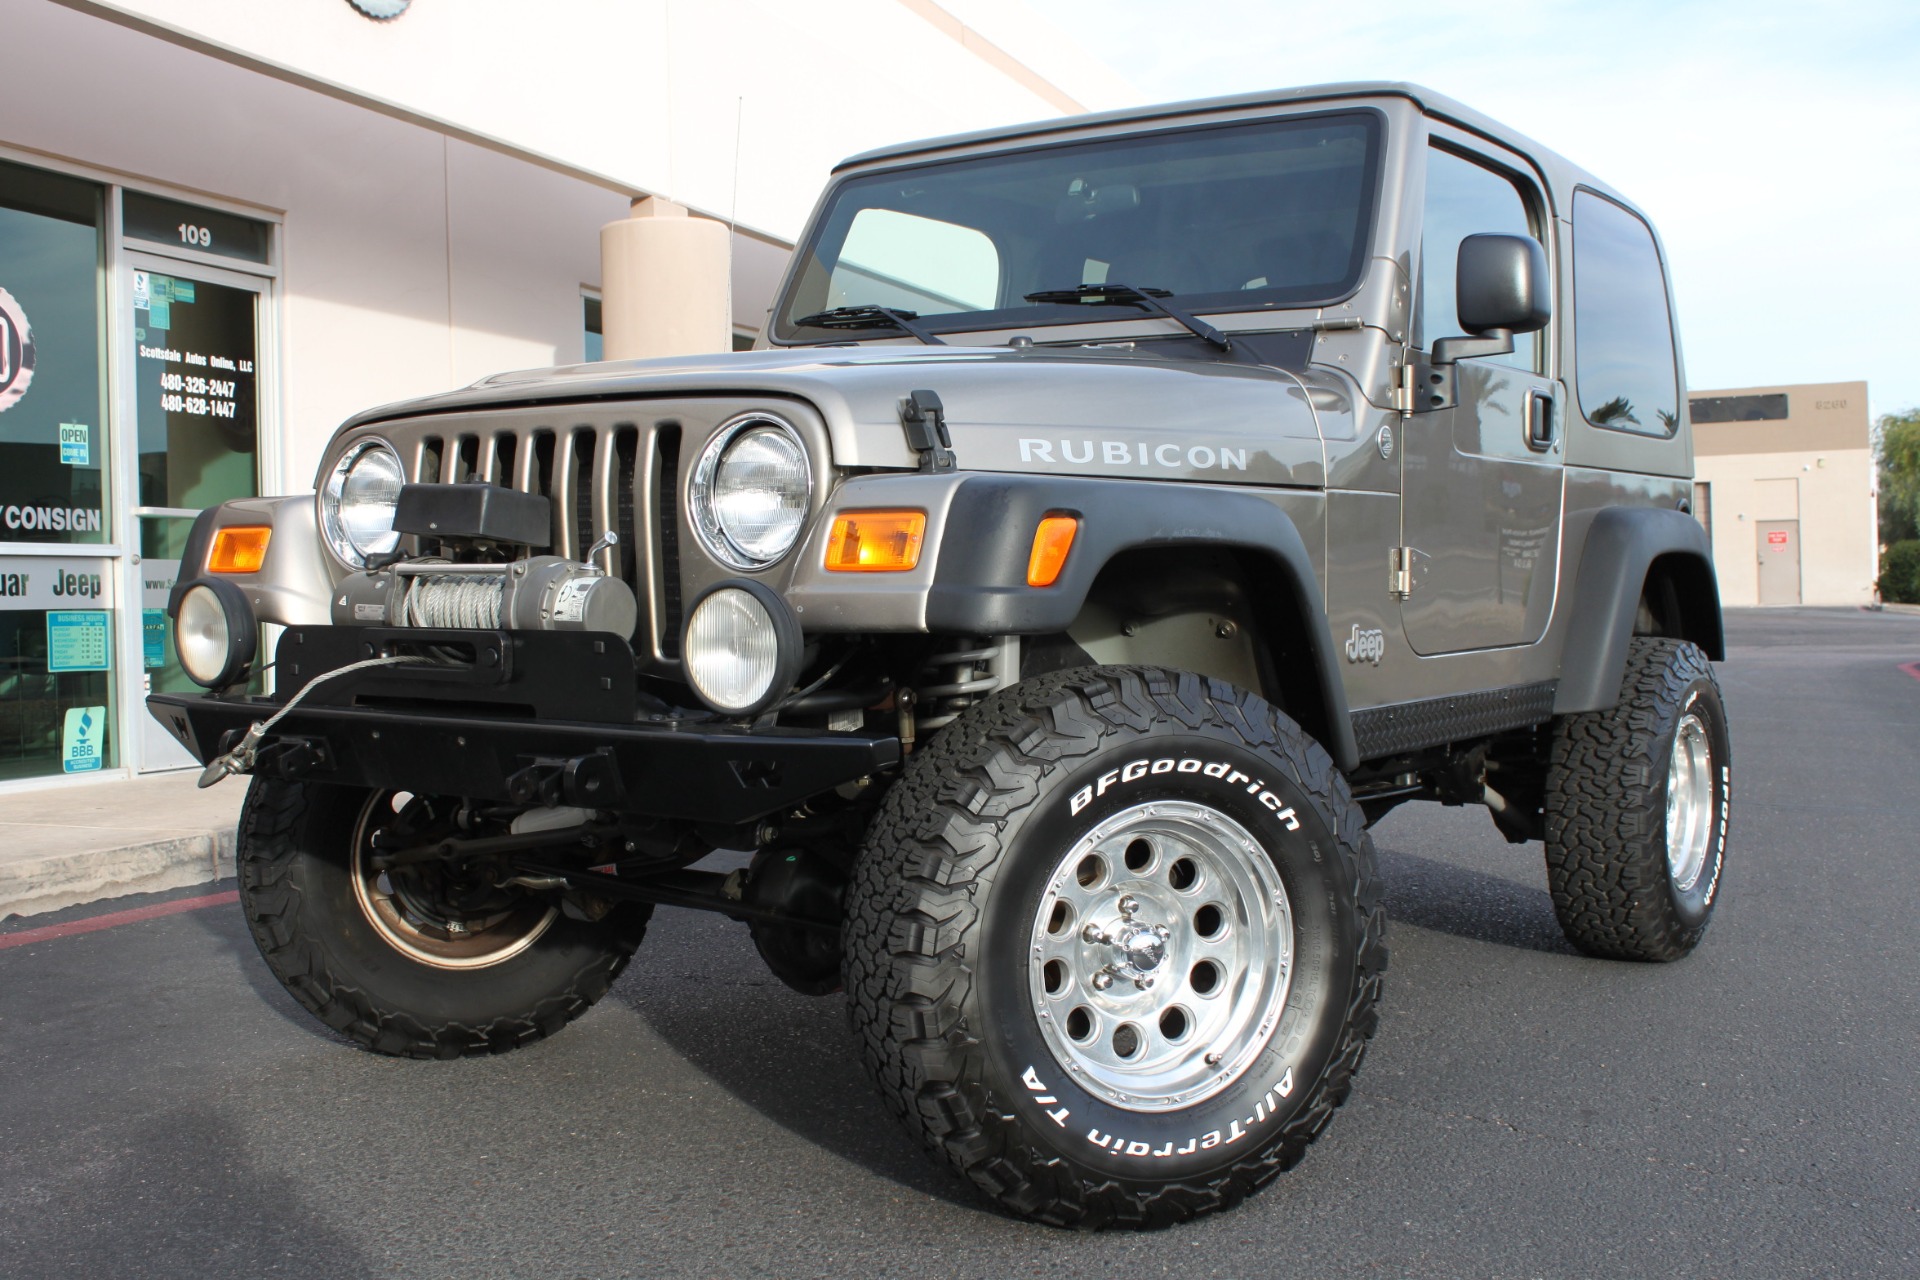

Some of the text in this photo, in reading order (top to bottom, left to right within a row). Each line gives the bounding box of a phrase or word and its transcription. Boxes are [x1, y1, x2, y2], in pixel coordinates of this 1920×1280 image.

[178, 223, 211, 247] 109
[140, 345, 253, 372] Scottsdale Autos Online, LLC
[161, 373, 235, 398] 480-326-2447
[161, 394, 235, 418] 480-628-1447
[61, 429, 87, 443] OPEN
[1018, 438, 1247, 470] RUBICON
[52, 568, 101, 599] Jeep
[1346, 623, 1384, 666] Jeep
[71, 745, 94, 758] BBB
[1069, 758, 1301, 832] BFGoodrich
[1703, 766, 1730, 906] BFGoodrich
[1020, 1065, 1294, 1157] All-Terrain T/A
